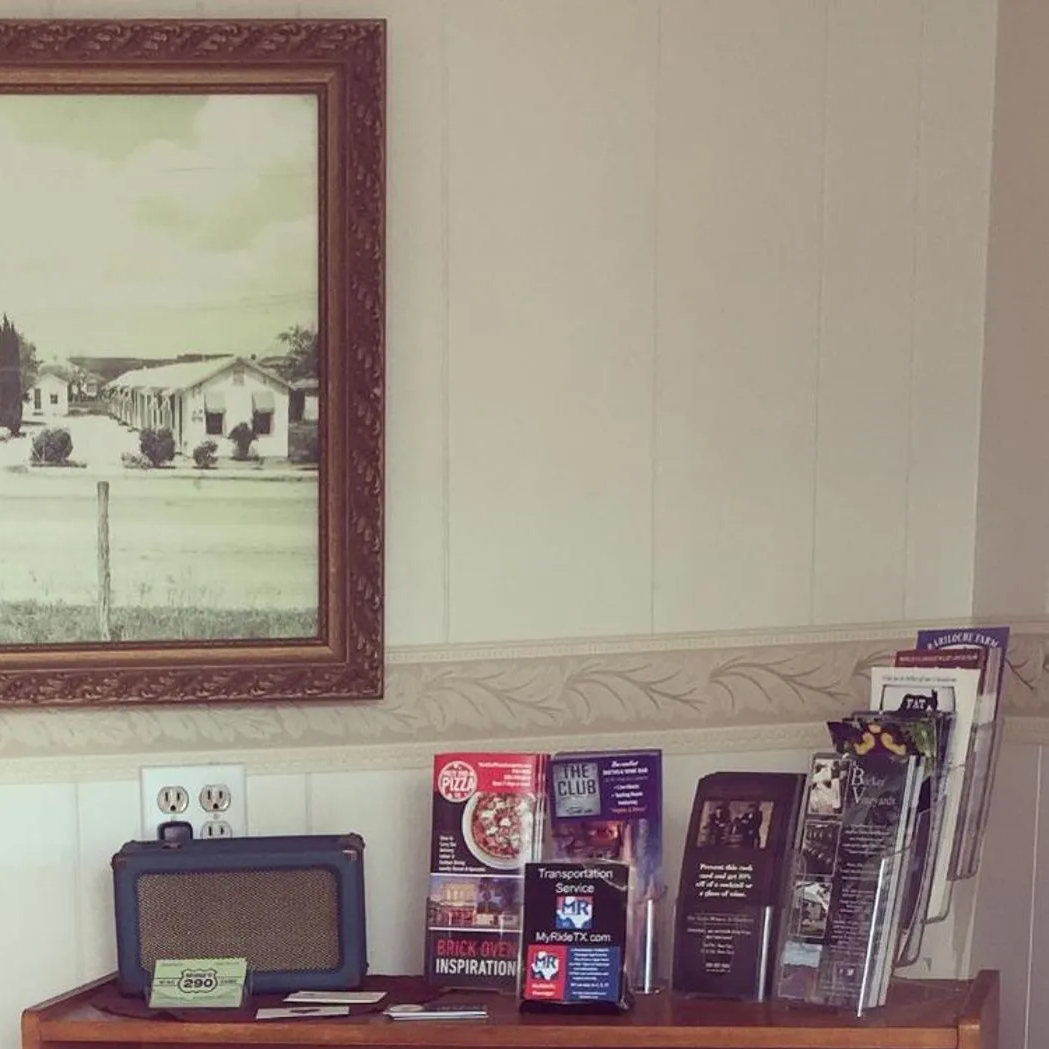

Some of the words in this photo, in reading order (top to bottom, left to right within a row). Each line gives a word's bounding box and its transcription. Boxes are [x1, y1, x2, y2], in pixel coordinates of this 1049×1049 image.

[563, 764, 589, 779] THE
[442, 777, 475, 792] PIZZA
[557, 780, 596, 796] CLUB
[538, 868, 614, 880] Transportation
[555, 882, 595, 894] Service
[562, 900, 589, 915] MR
[437, 939, 476, 957] BRICK
[435, 958, 517, 976] INSPIRATION
[183, 979, 213, 988] 290
